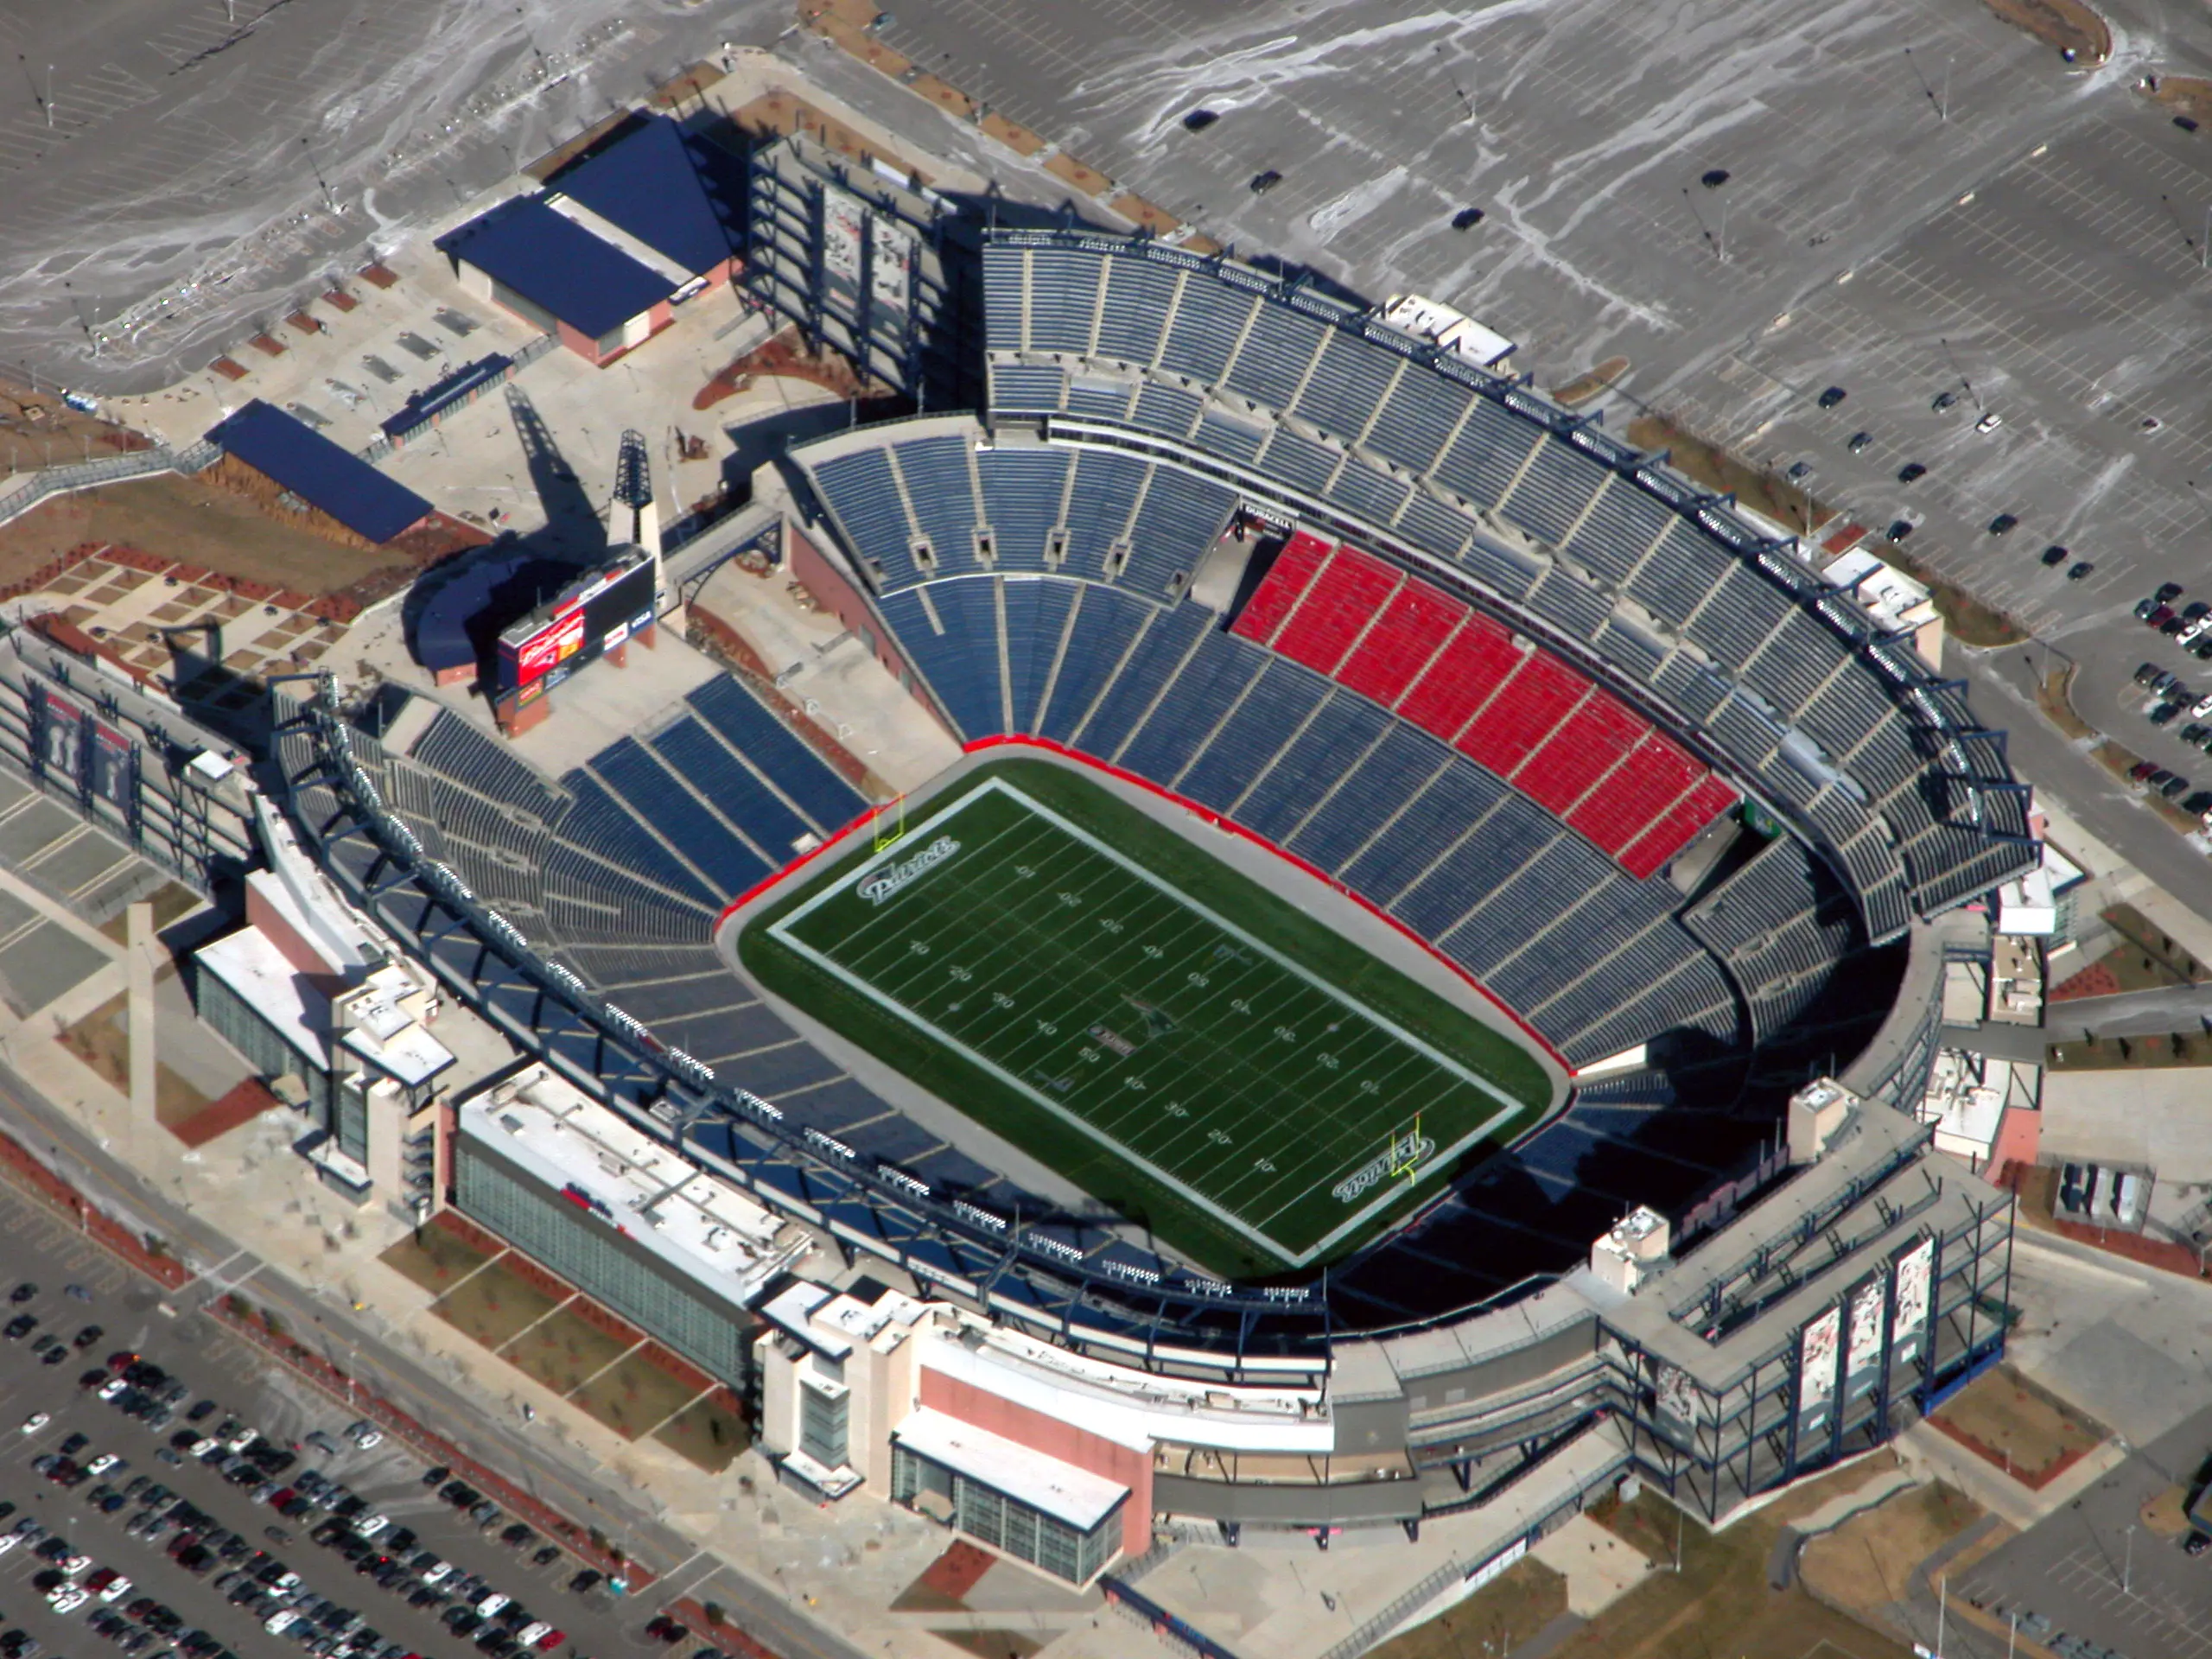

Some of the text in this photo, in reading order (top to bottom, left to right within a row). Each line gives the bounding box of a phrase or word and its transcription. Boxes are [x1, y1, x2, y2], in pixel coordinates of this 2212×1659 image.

[1245, 505, 1291, 530] DURACELL
[856, 836, 961, 906] Patriots
[1332, 1130, 1435, 1203] Patriots
